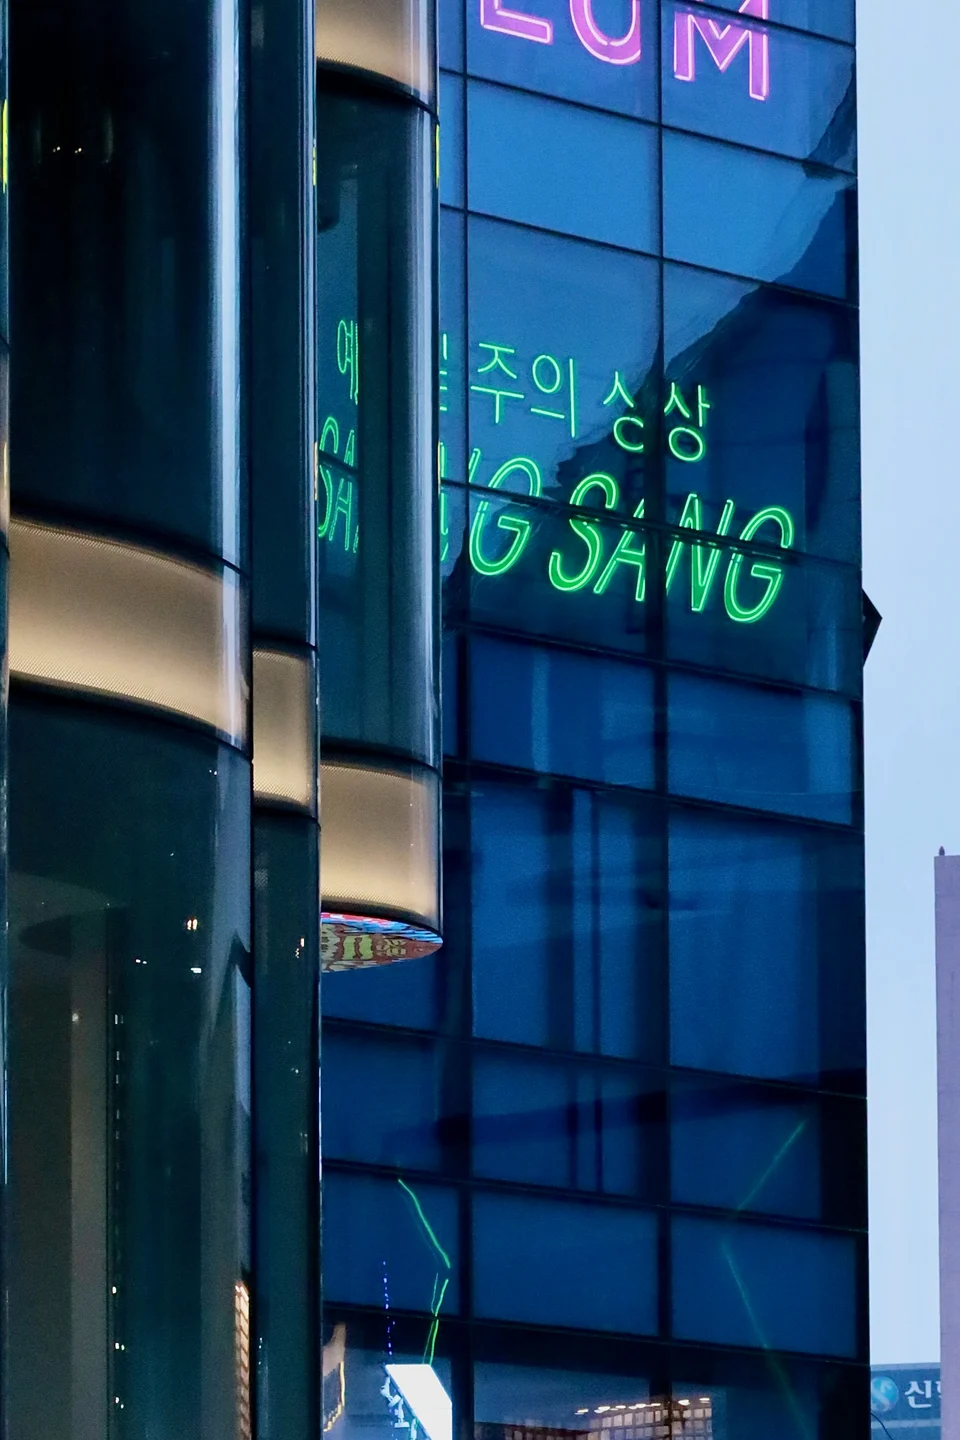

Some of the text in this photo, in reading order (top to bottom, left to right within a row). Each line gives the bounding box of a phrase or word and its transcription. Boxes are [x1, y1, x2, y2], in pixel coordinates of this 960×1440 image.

[439, 333, 575, 438] 주의
[549, 474, 794, 623] SANG
[904, 1379, 941, 1409] 신
